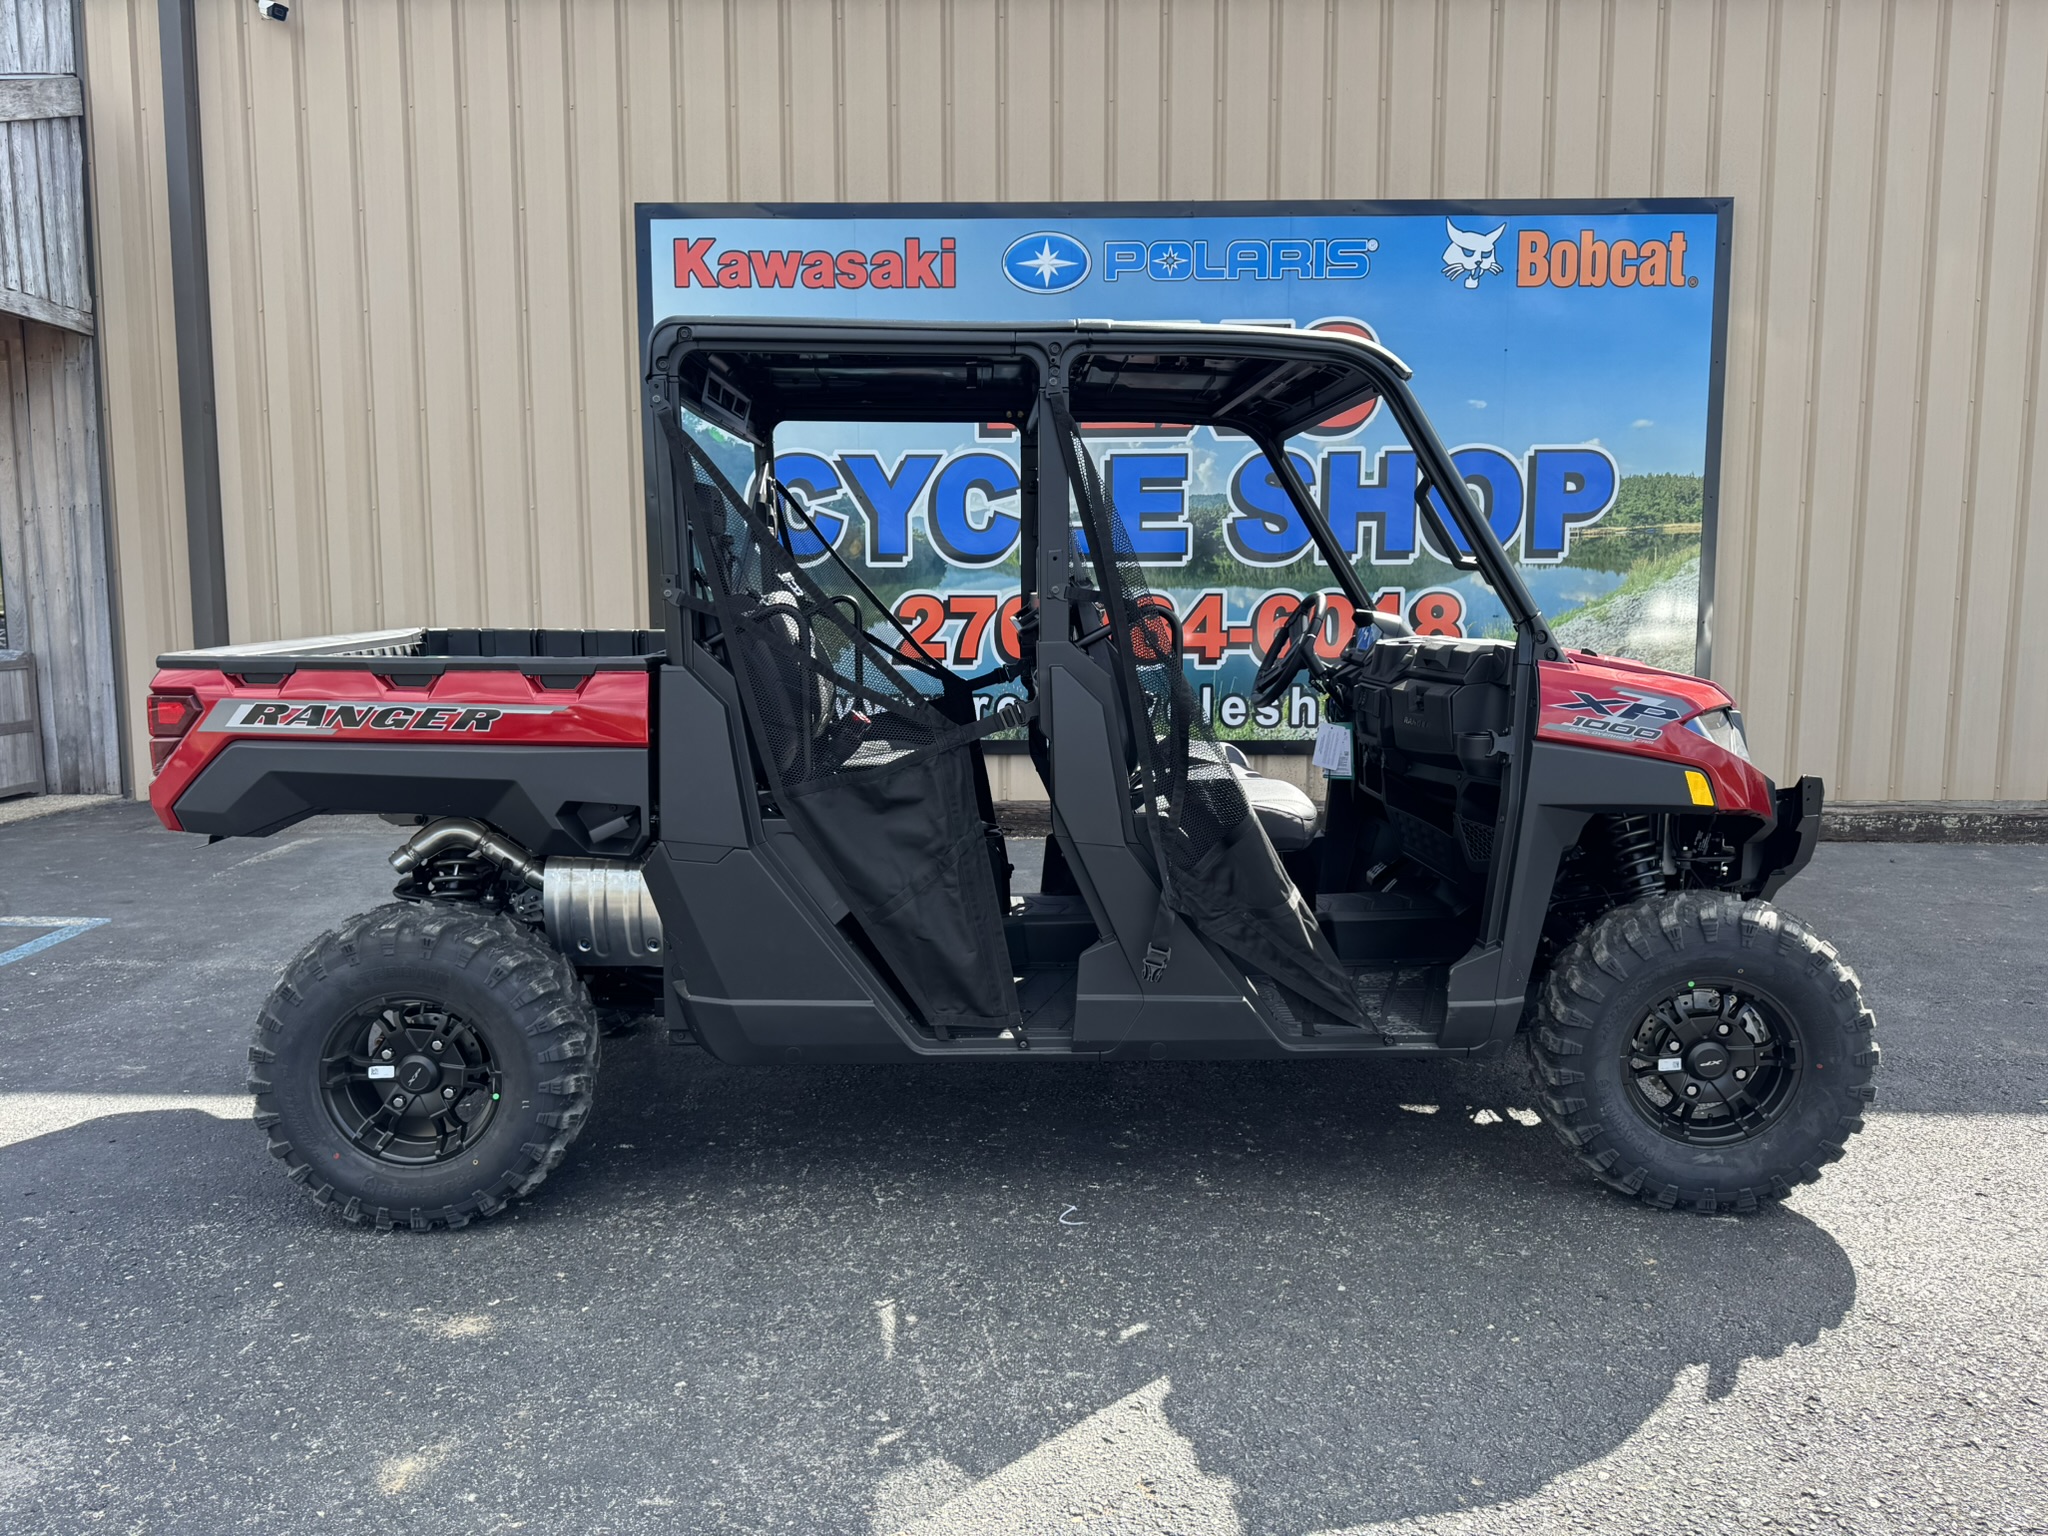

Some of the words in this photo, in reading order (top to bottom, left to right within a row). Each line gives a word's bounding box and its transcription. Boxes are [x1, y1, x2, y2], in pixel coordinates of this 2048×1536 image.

[673, 237, 956, 289] Kawasaki
[1103, 239, 1370, 281] POLARIS
[1516, 229, 1687, 288] Bobcat
[752, 450, 1194, 568] CYCE
[1226, 446, 1616, 564] SHOP
[239, 703, 503, 732] RANGER
[1549, 690, 1681, 721] XP
[1572, 715, 1663, 740] 1000
[1591, 730, 1636, 743] OVERHEAD
